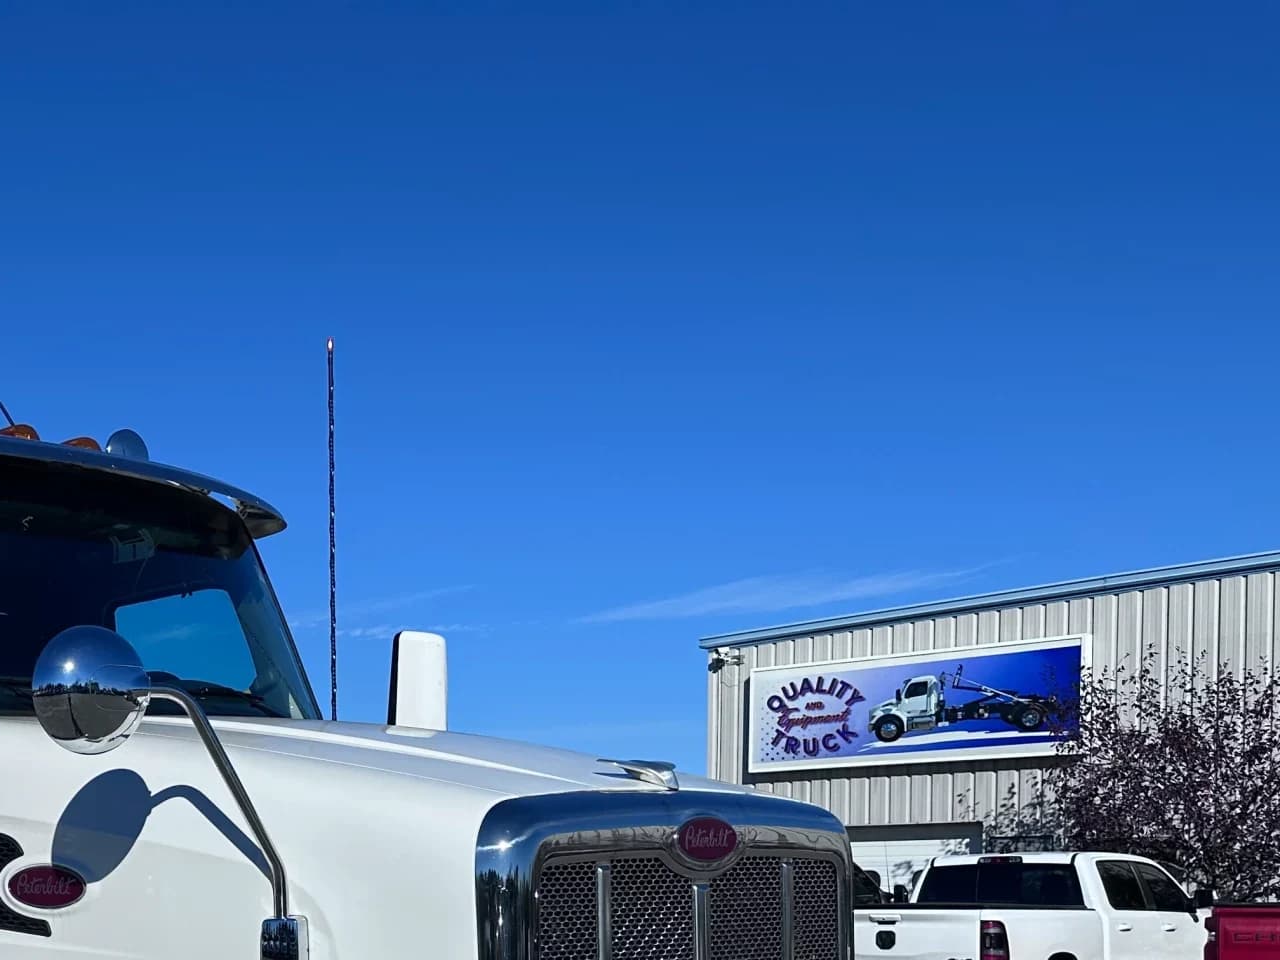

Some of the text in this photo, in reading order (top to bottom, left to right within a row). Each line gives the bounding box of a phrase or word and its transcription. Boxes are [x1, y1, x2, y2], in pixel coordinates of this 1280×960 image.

[767, 676, 865, 712] QUALITY
[805, 701, 825, 711] AND
[777, 707, 851, 733] Equipment
[771, 722, 858, 757] TRUCK
[685, 825, 733, 850] Peterbilt
[16, 873, 77, 896] Peterbilt
